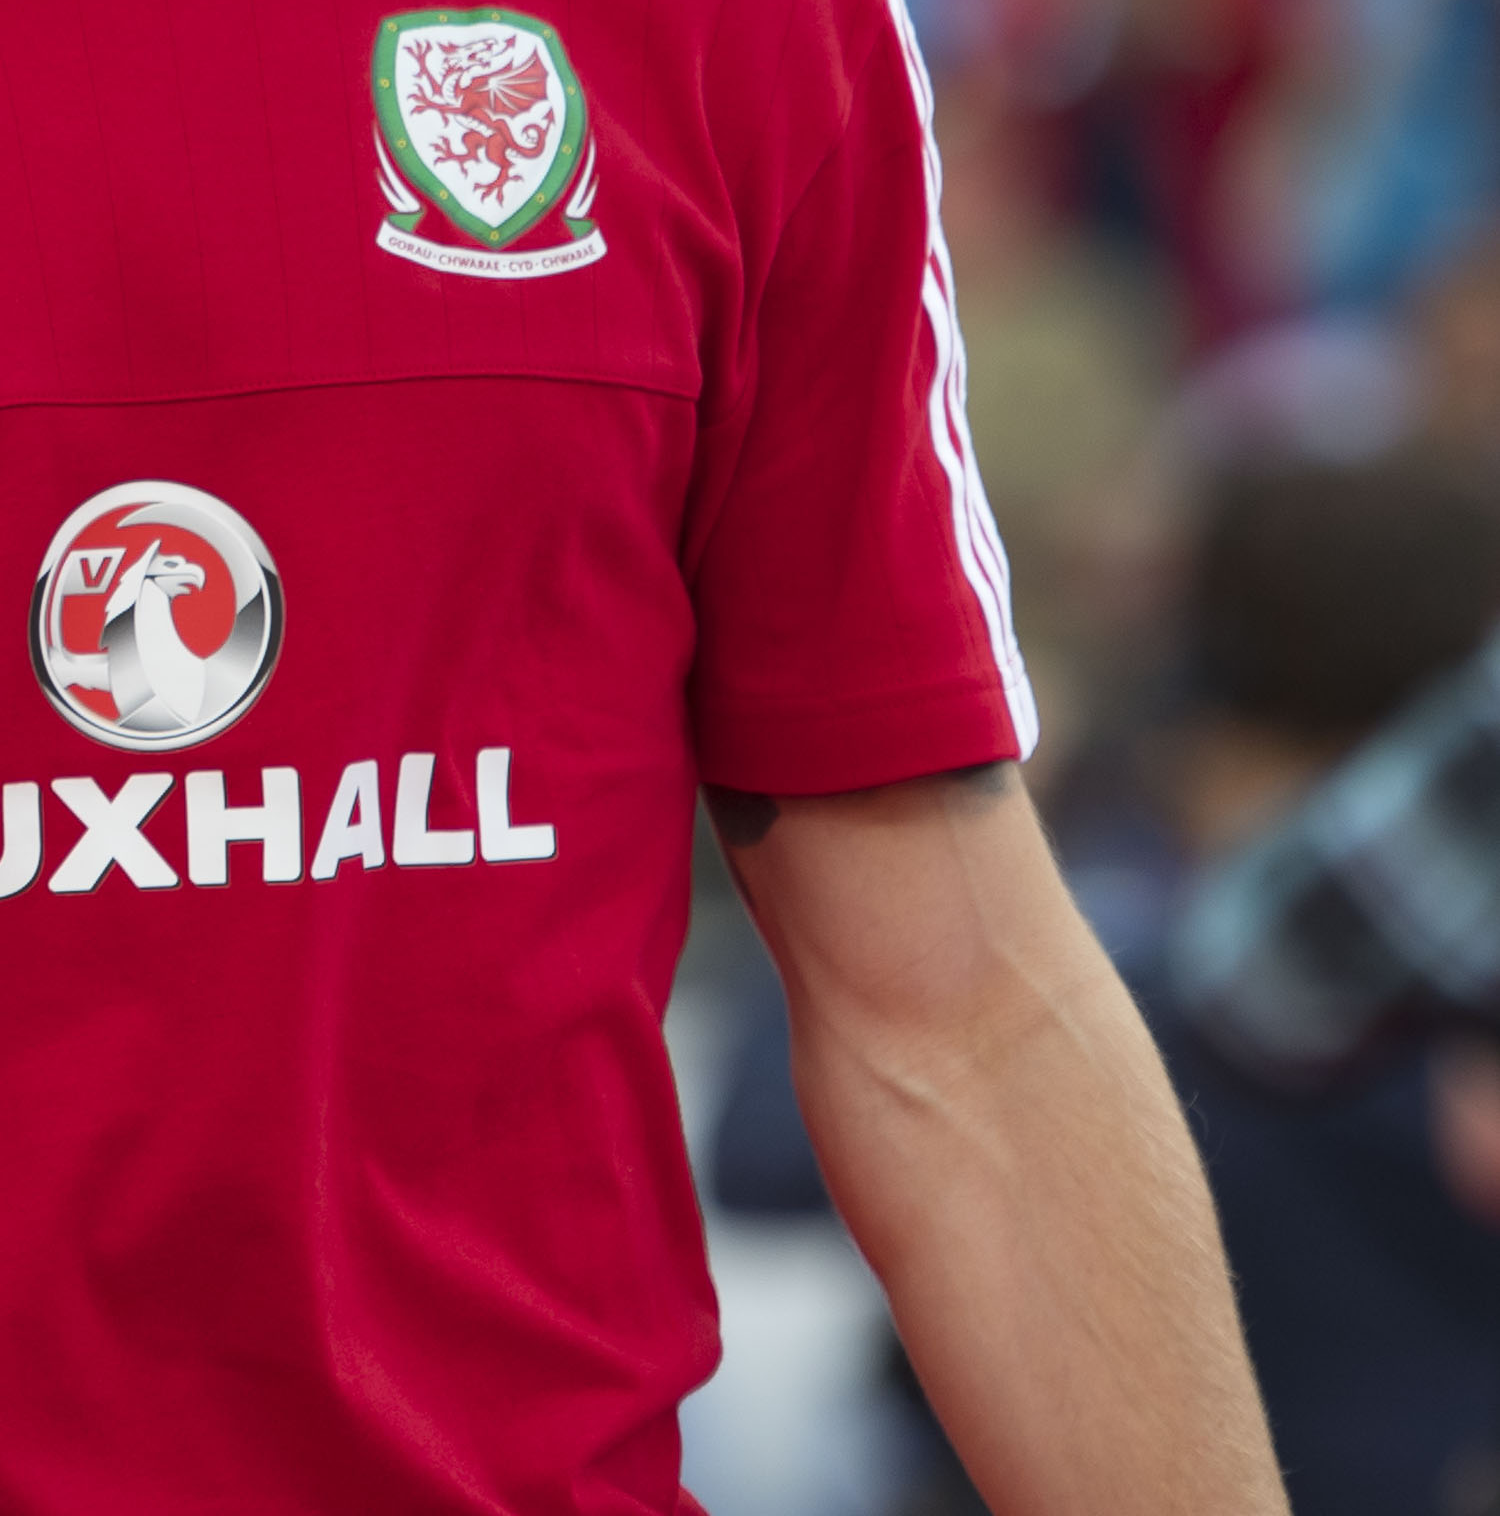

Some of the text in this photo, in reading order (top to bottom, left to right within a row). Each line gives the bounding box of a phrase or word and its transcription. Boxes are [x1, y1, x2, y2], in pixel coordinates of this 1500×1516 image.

[388, 236, 596, 272] GORAU CHWARAE CYD CHWARAE
[79, 556, 113, 589] V
